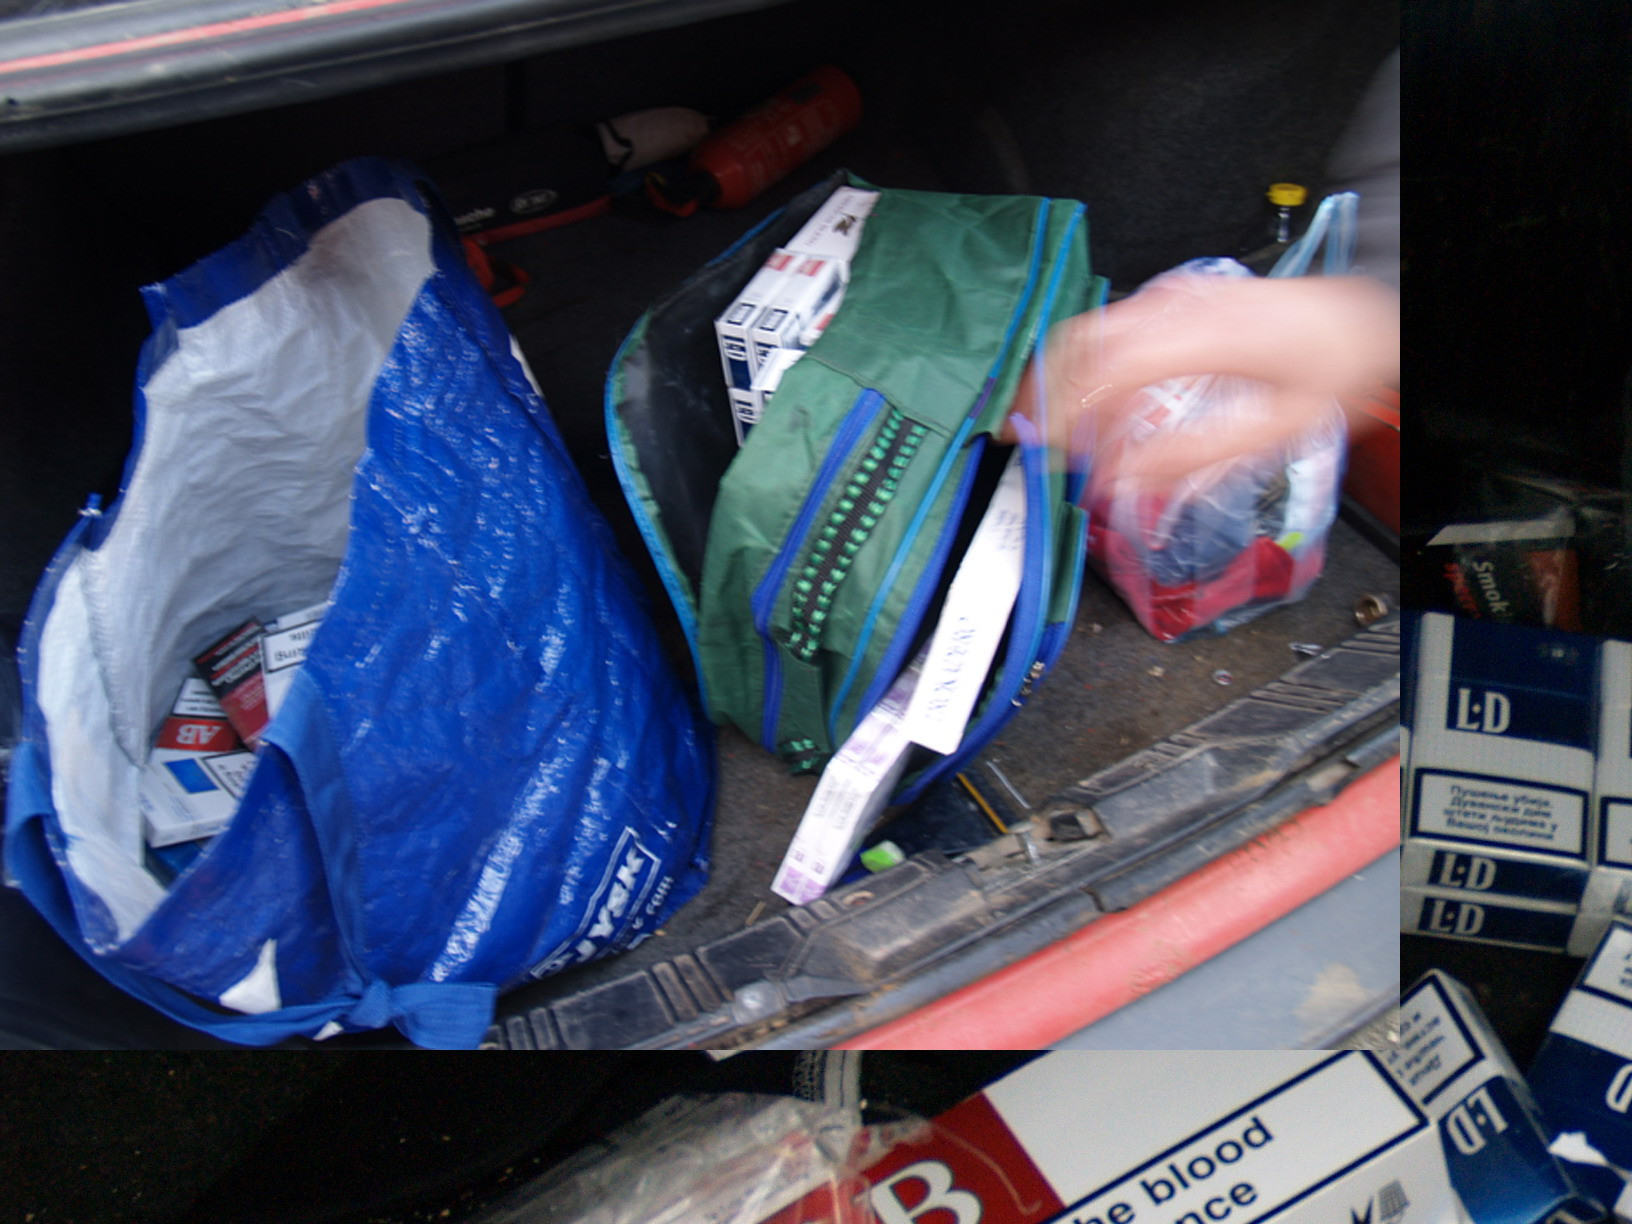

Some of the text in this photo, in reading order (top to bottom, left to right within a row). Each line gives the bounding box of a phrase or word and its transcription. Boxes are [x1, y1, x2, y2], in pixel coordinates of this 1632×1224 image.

[176, 723, 222, 745] AB
[575, 846, 646, 963] JYSK
[1142, 1116, 1277, 1207] blood
